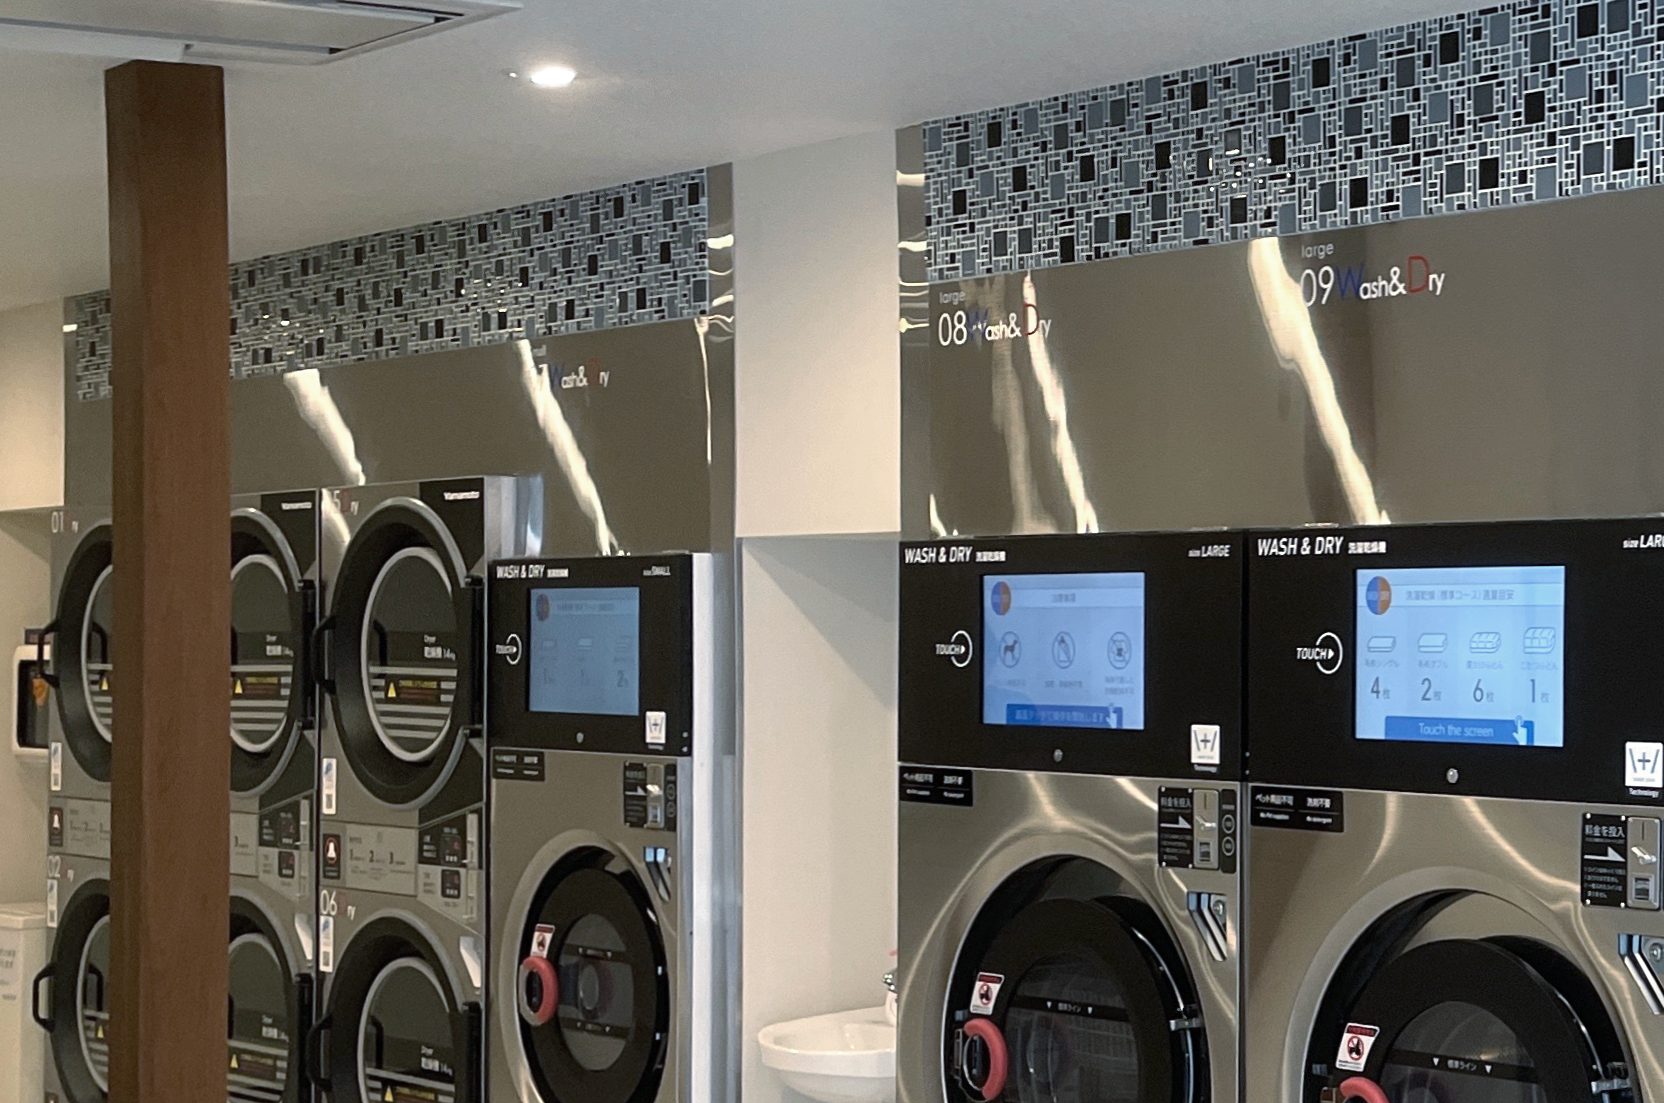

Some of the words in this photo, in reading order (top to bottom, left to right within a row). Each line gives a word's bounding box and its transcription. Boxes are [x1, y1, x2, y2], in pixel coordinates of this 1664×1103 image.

[1301, 243, 1334, 259] large
[1300, 265, 1335, 307] 09
[938, 310, 968, 346] 08
[1201, 545, 1231, 557] LARGE
[1257, 538, 1299, 556] WASH
[1300, 537, 1312, 555] &
[1314, 536, 1344, 555] DRY
[904, 547, 937, 563] WASH
[938, 546, 947, 563] &
[949, 546, 973, 563] DRY
[496, 565, 520, 578] WASH
[520, 564, 527, 578] &
[528, 564, 545, 578] DRY
[935, 644, 961, 656] TOUCH
[1296, 647, 1329, 661] TOUCH
[1418, 722, 1445, 735] Touch
[1448, 723, 1462, 736] the
[1463, 726, 1494, 737] screen
[320, 889, 338, 915] 06
